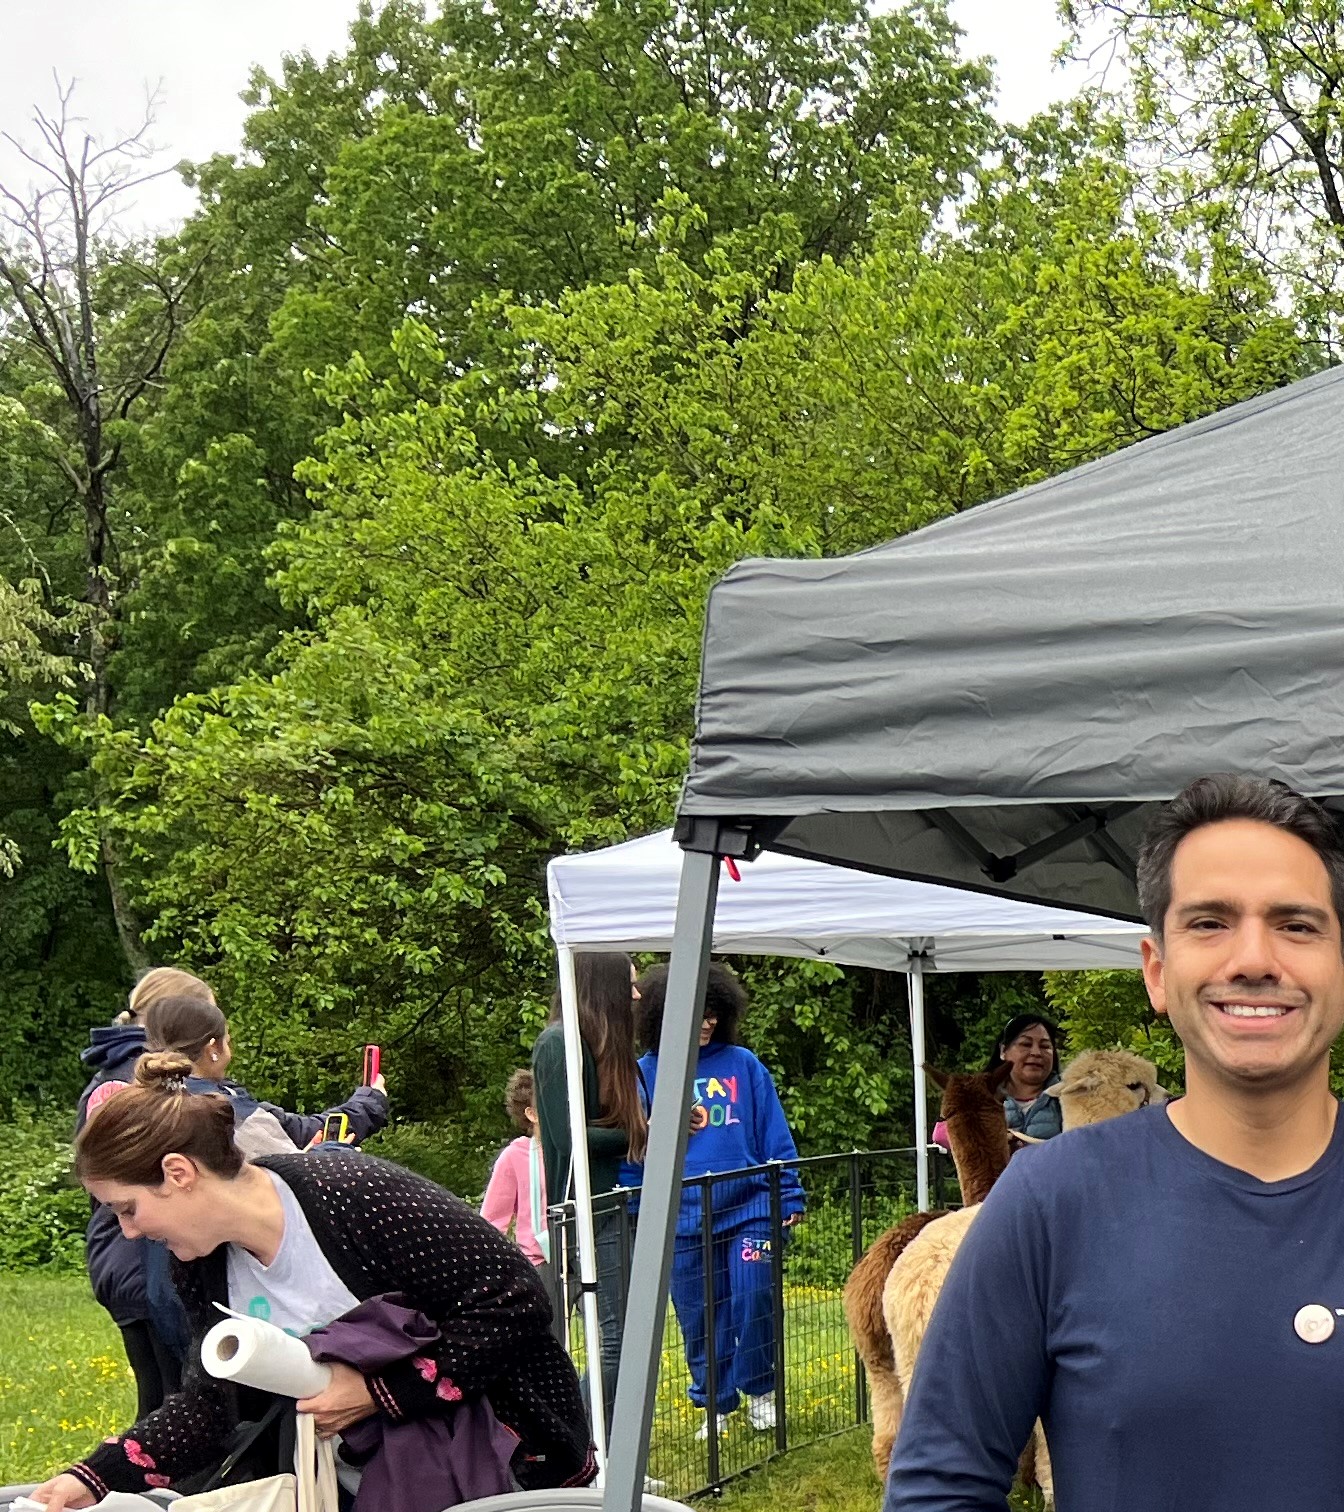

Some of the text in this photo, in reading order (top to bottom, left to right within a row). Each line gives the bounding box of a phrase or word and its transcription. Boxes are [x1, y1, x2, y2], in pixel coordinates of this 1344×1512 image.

[694, 1076, 737, 1103] TAY
[695, 1104, 740, 1127] OOL
[741, 1237, 772, 1251] STA
